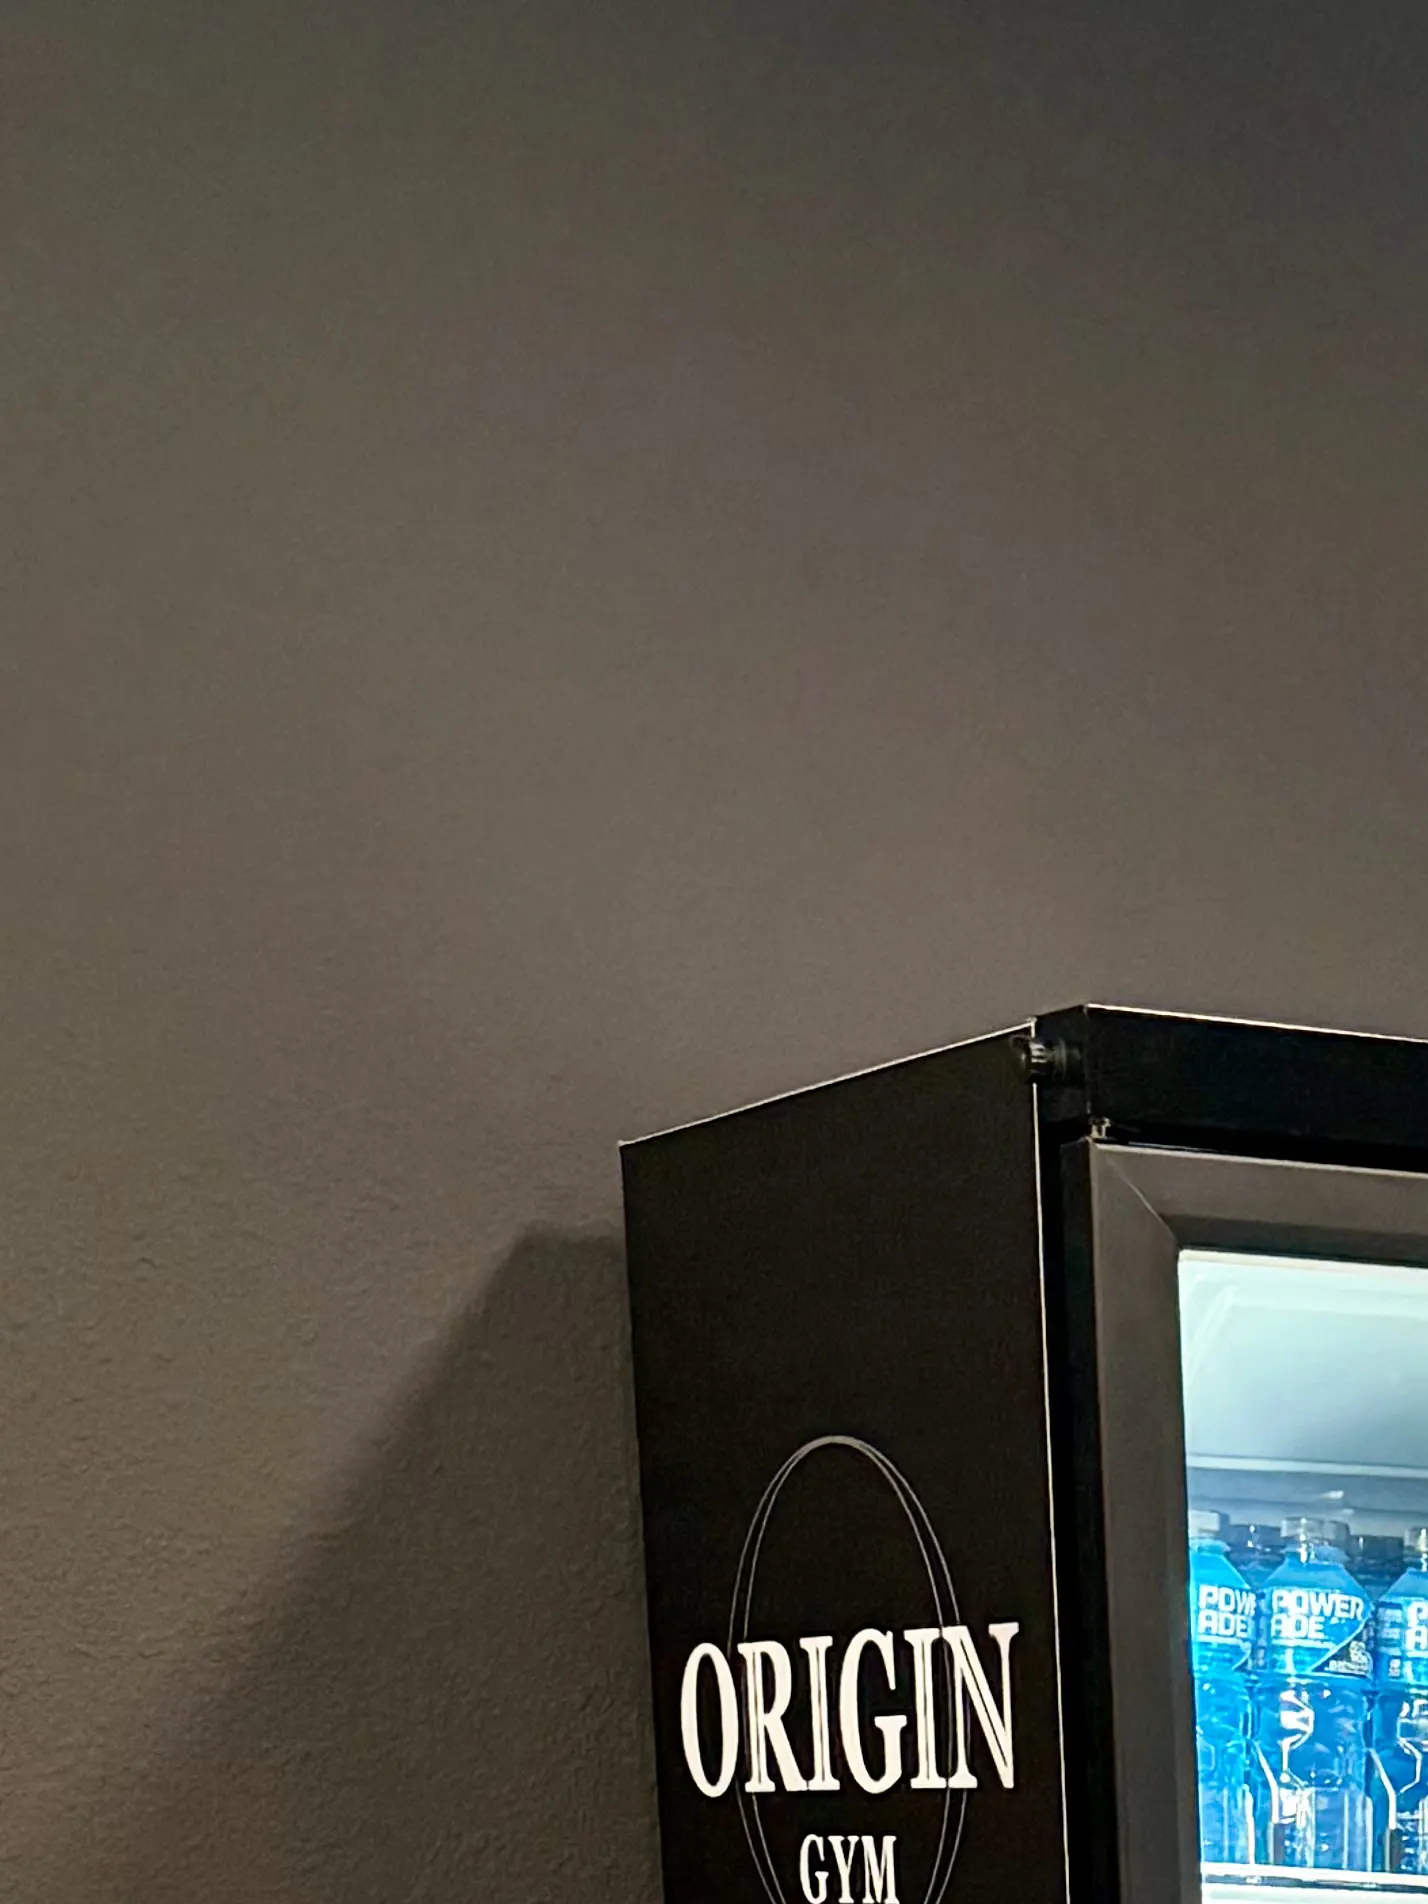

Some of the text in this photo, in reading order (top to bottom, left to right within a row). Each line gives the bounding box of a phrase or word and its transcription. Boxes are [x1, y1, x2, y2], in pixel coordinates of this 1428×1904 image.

[1271, 1613, 1326, 1638] ADE
[1272, 1587, 1364, 1620] POWER
[681, 1622, 1019, 1797] ORIGIN
[800, 1834, 899, 1904] GYM
